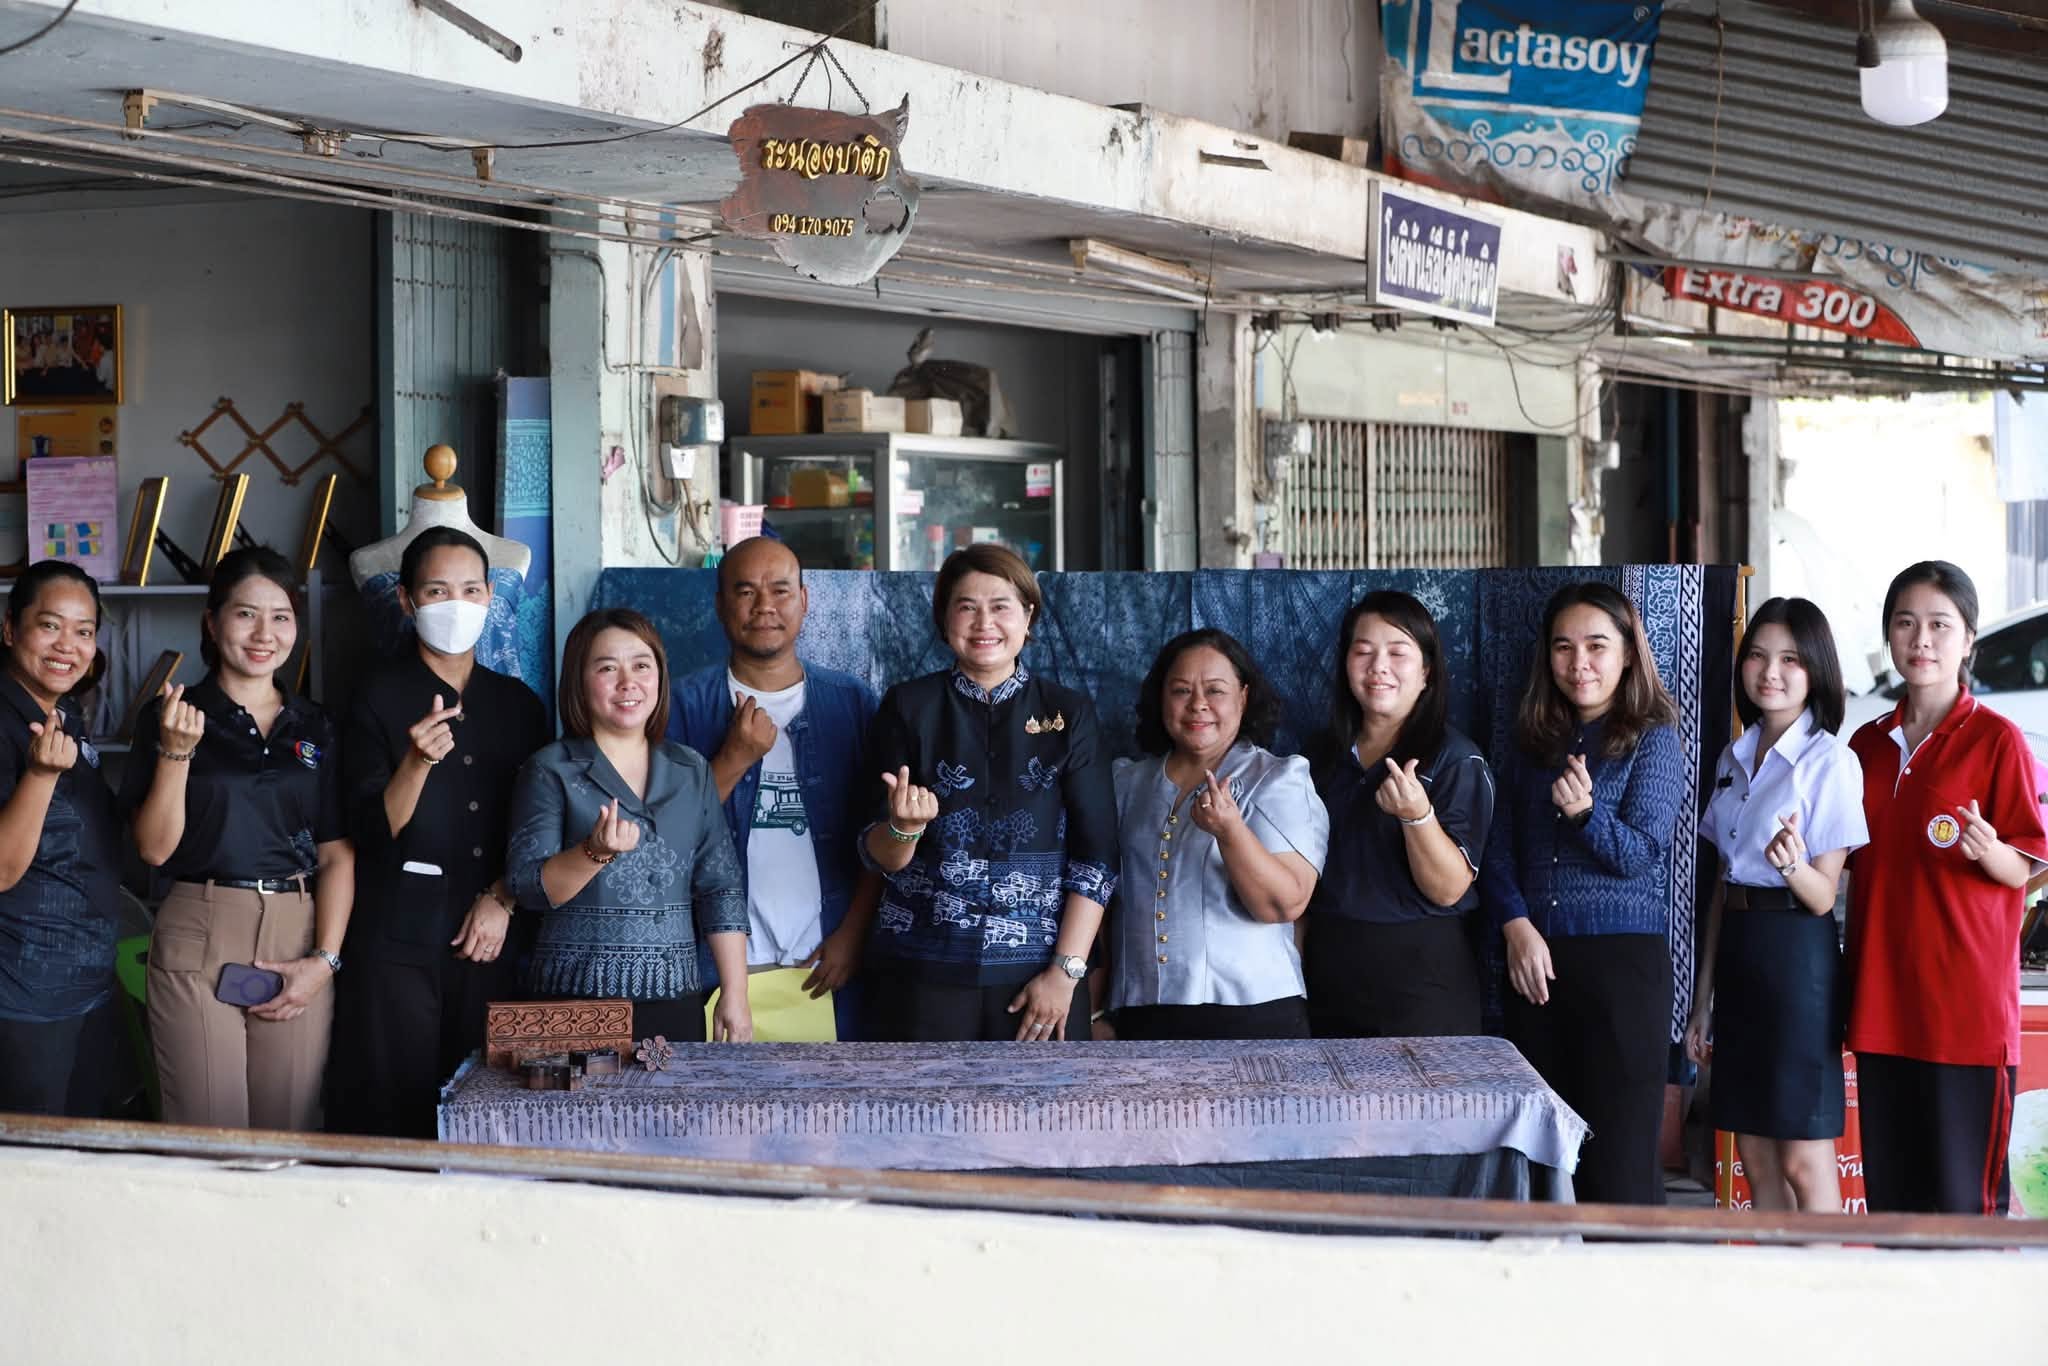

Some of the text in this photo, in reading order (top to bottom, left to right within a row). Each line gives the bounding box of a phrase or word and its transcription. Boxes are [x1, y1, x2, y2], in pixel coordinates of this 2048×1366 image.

[1421, 0, 1648, 94] Lactasoy
[764, 134, 891, 182] ระนองบาติก
[774, 214, 854, 236] 094 170 9075
[1681, 266, 1876, 329] Extra 300
